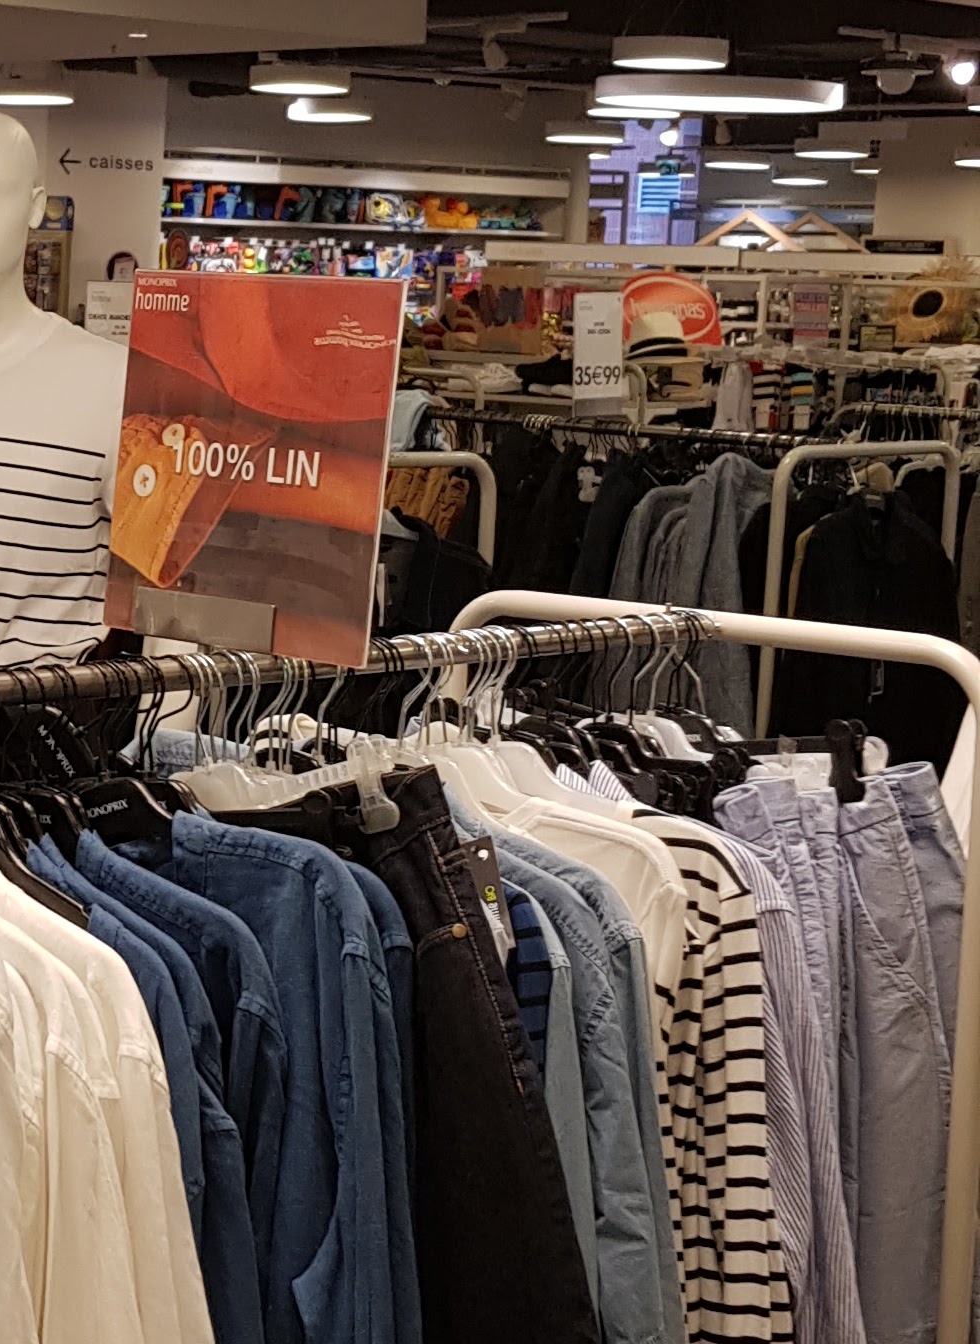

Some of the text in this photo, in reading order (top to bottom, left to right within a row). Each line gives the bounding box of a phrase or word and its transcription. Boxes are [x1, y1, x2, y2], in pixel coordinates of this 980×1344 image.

[89, 155, 154, 171] caisses
[135, 287, 189, 312] homme
[575, 365, 621, 386] 35€99
[173, 440, 320, 488] 100% LIN
[87, 799, 128, 819] ONOPRIX
